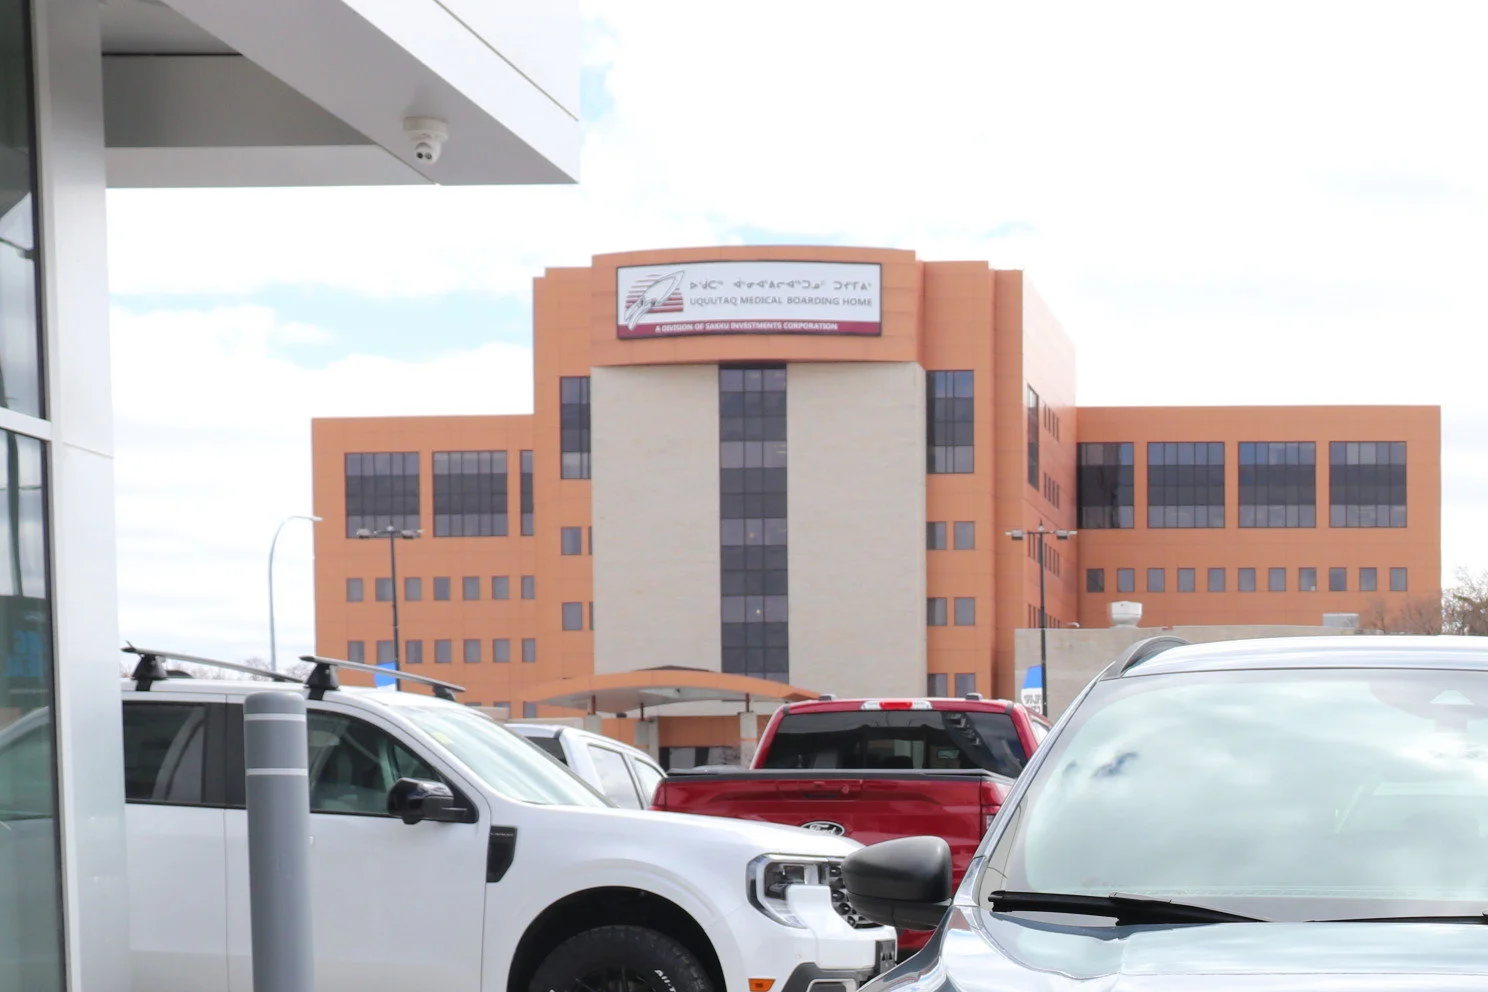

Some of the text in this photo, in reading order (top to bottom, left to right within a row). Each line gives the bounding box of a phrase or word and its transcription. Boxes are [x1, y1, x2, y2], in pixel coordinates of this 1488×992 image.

[689, 296, 872, 307] UQUUTAQ MEDICAL BOARDING HOME
[661, 323, 693, 333] DIVISION
[694, 322, 705, 332] OF
[730, 321, 782, 330] INVESTMENTS
[783, 321, 838, 330] CORPORATION
